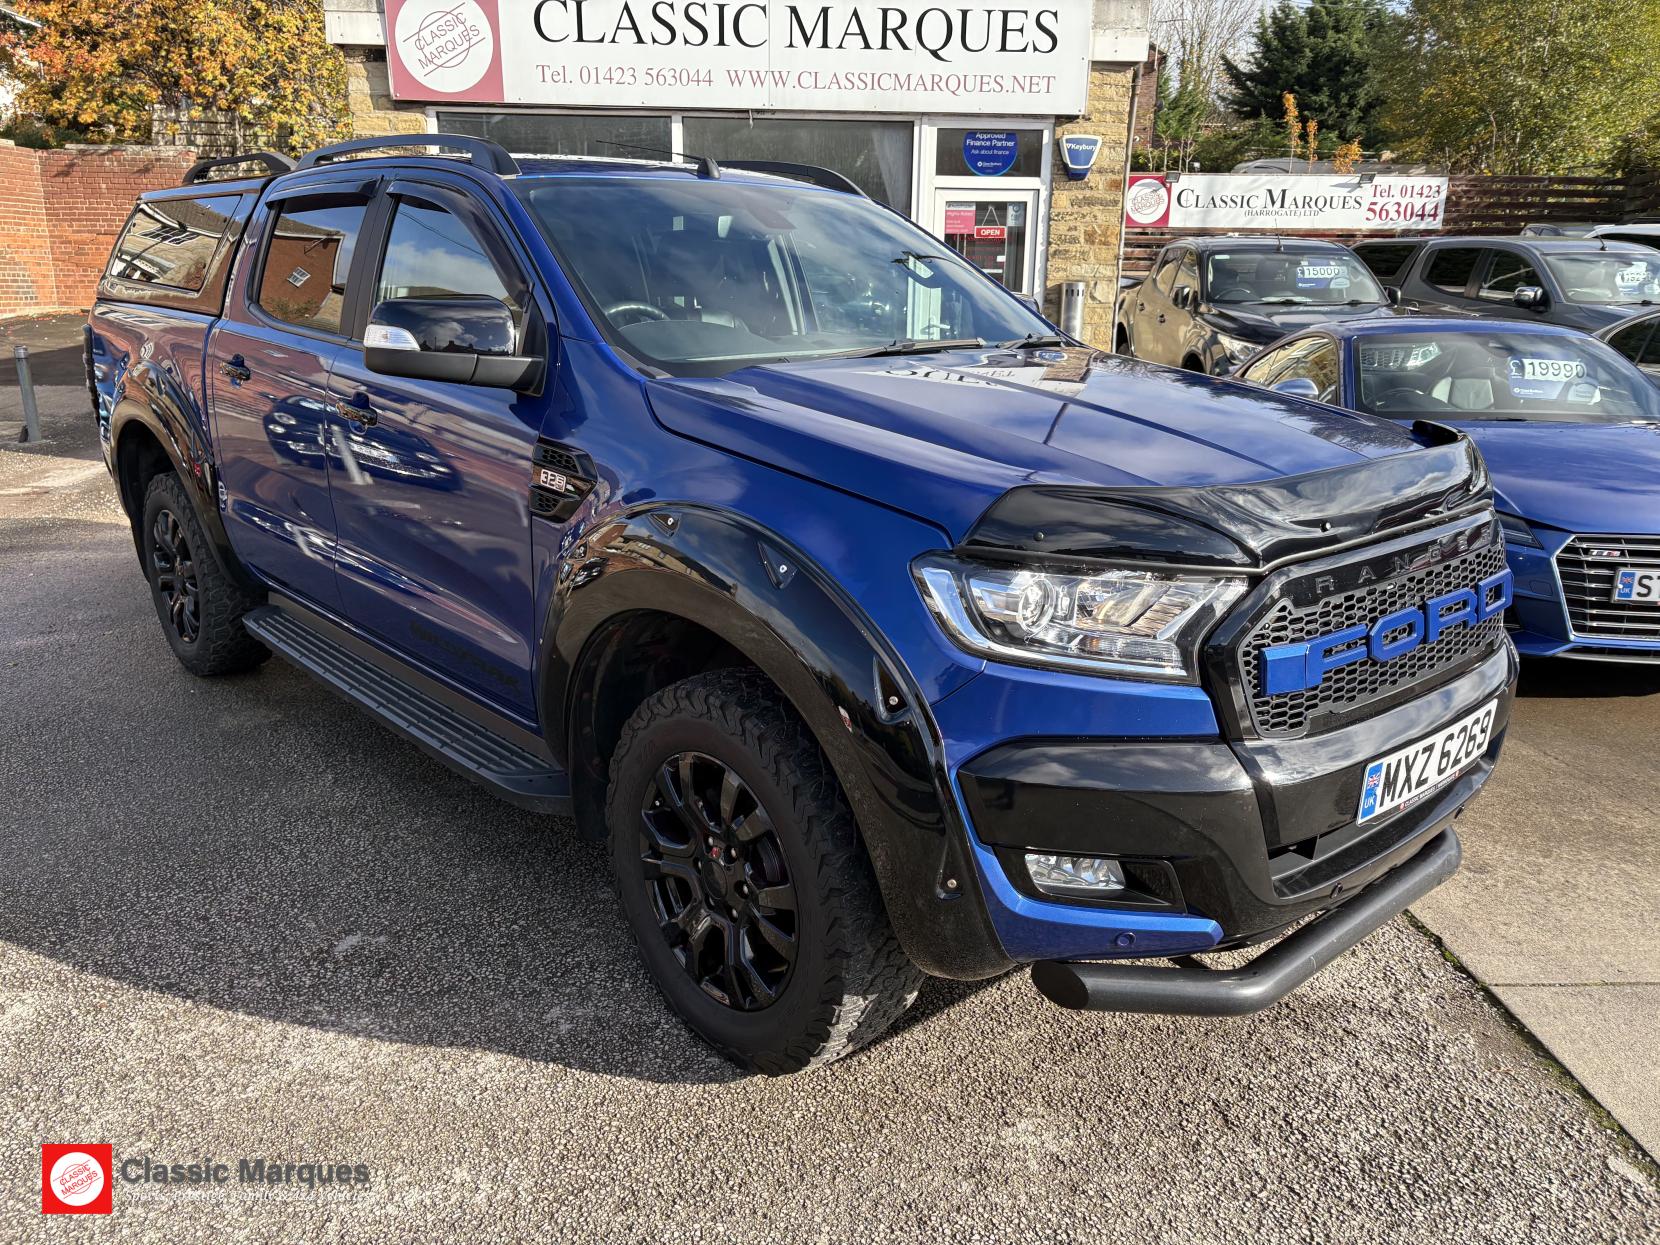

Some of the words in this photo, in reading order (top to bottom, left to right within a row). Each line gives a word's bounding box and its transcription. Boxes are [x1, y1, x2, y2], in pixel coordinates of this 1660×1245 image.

[415, 12, 467, 51] CLASSIC
[533, 0, 768, 48] CLASSIC
[785, 5, 1059, 63] MARQUES
[418, 24, 480, 69] MARQUES
[536, 64, 573, 84] Tel.
[579, 65, 637, 86] 01423
[645, 67, 714, 88] 563044
[726, 69, 1056, 96] WWW.CLASSICMARQUES.NET
[966, 139, 991, 147] Finance
[1370, 184, 1395, 198] Tel.
[1400, 184, 1441, 199] 01423
[1244, 209, 1302, 217] (HARROGATE)
[1365, 201, 1440, 222] 563044
[1636, 574, 1660, 598] S
[1260, 568, 1514, 697] FORD
[1379, 741, 1437, 808] MXZ
[1436, 708, 1492, 777] 6269
[1364, 795, 1375, 809] UK
